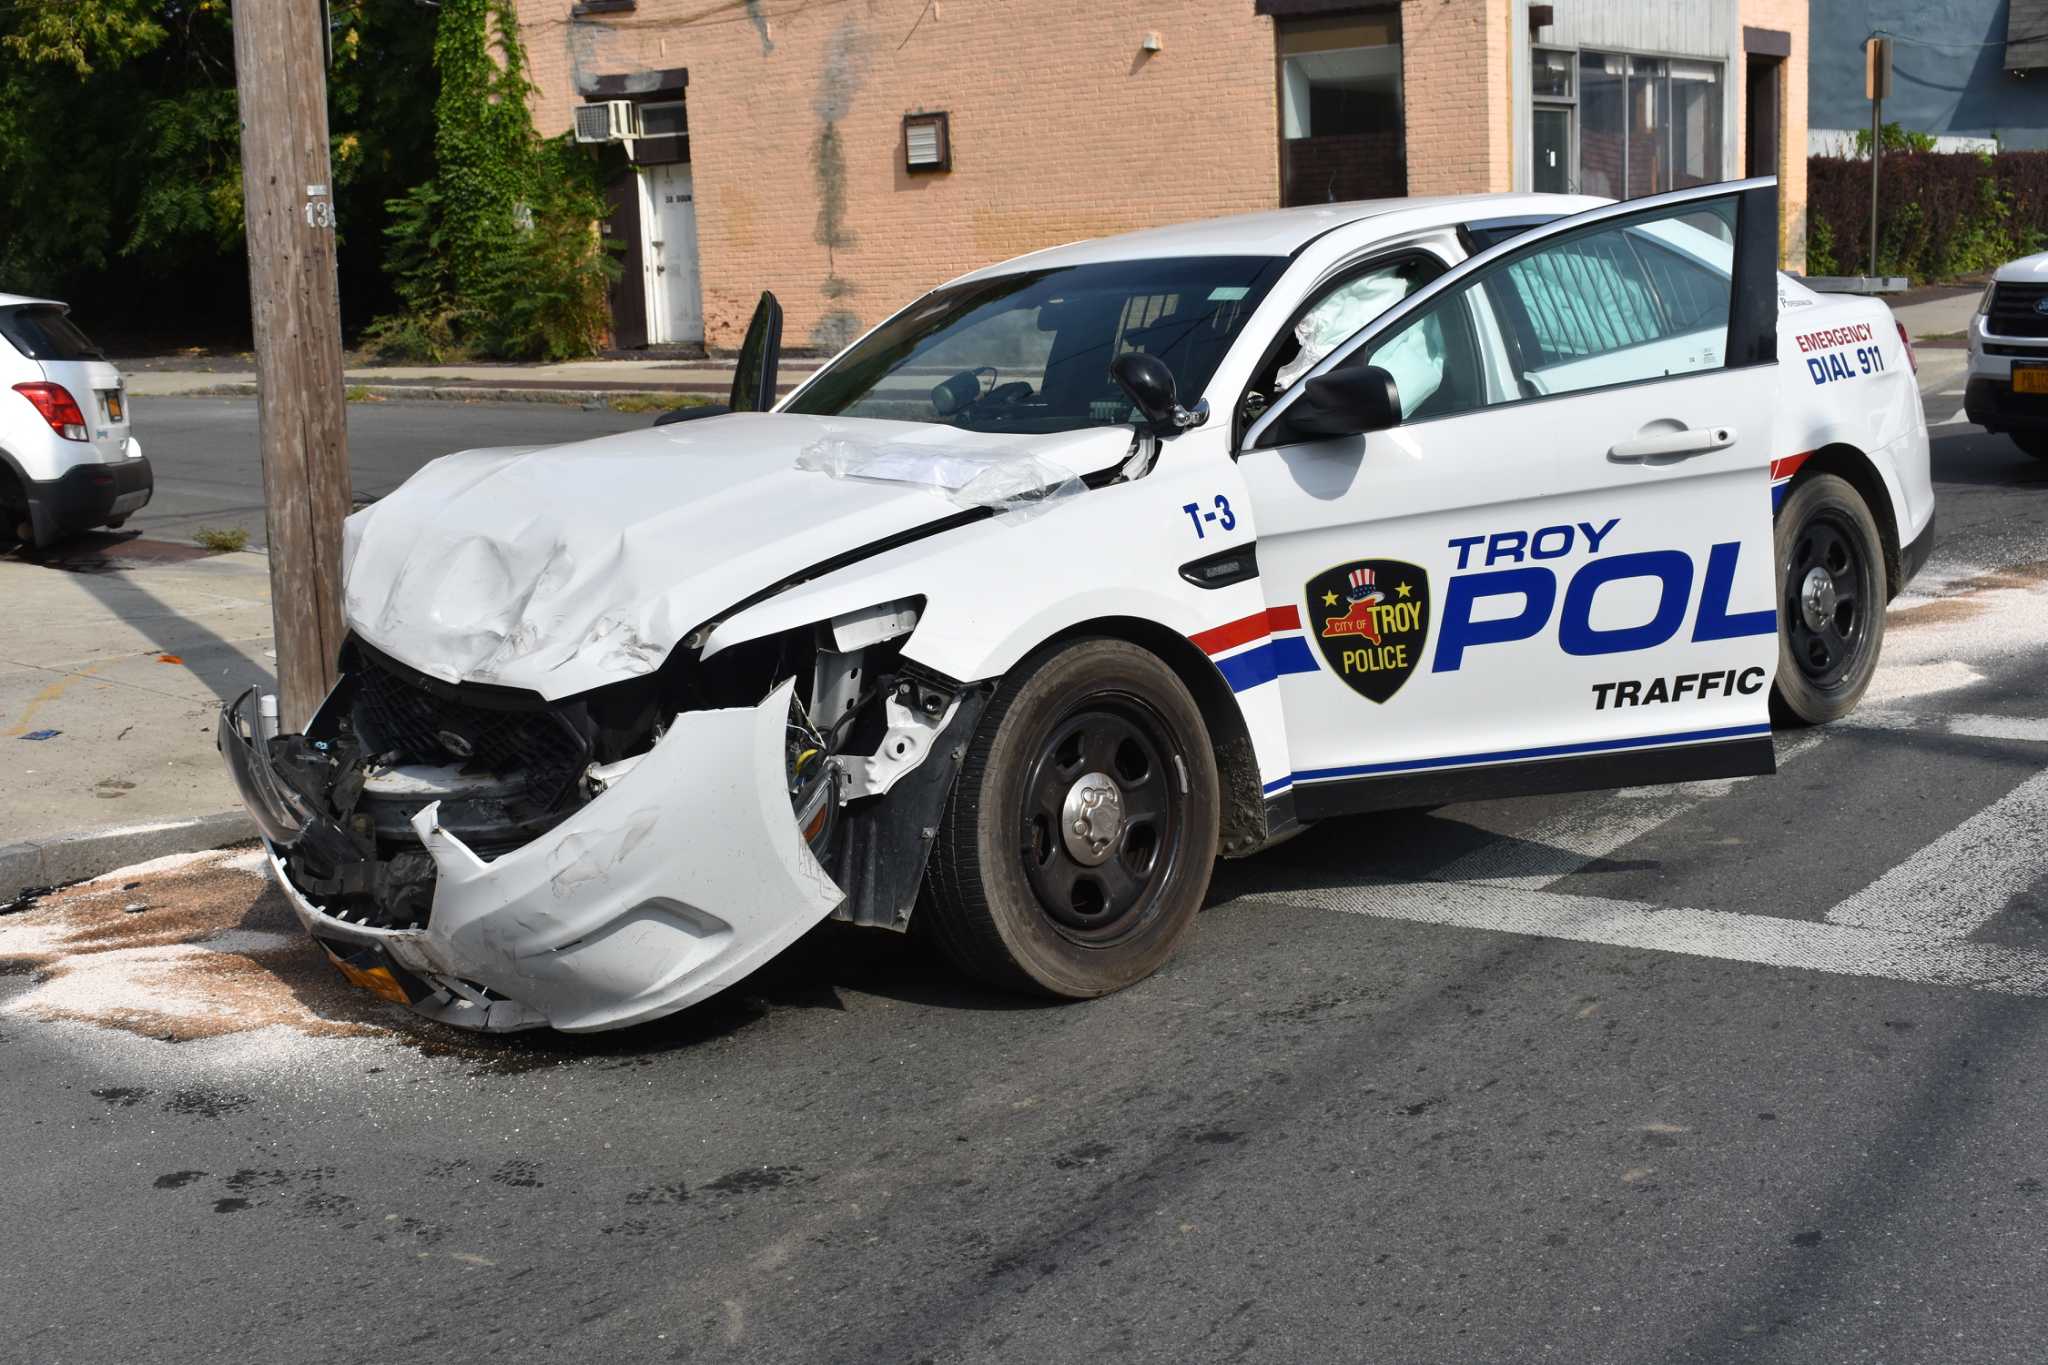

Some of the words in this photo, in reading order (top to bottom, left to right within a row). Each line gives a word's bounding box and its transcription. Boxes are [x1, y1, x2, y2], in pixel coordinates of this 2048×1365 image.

[1795, 323, 1873, 353] EMERGENCY
[1806, 352, 1856, 386] DIAL
[1857, 345, 1885, 375] 911
[1182, 494, 1236, 540] T-3
[1447, 518, 1622, 570] TROY
[1334, 622, 1353, 633] CITY
[1356, 620, 1367, 630] OF
[1366, 601, 1421, 634] TROY
[1431, 541, 1778, 674] POL
[1342, 644, 1408, 674] POLICE
[1591, 666, 1766, 711] TRAFFIC
